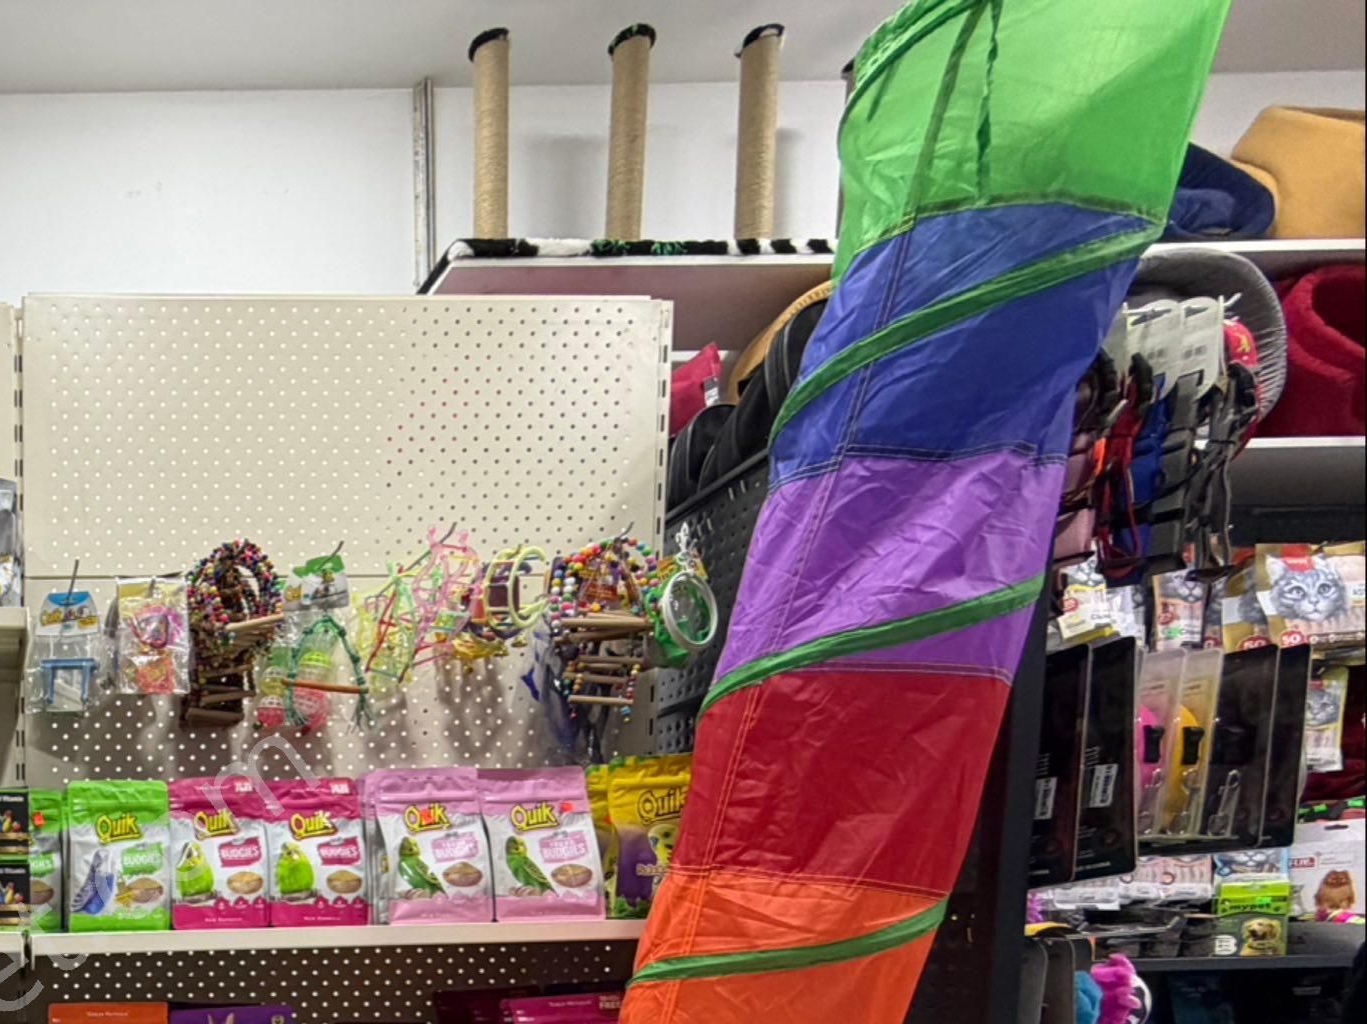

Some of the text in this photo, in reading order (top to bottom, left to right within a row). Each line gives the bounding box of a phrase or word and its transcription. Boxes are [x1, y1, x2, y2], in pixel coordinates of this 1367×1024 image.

[96, 814, 142, 845] Quik
[194, 810, 239, 839] Quik
[290, 810, 337, 840] Quik
[510, 803, 558, 829] Quik
[221, 846, 260, 859] BUDGIES
